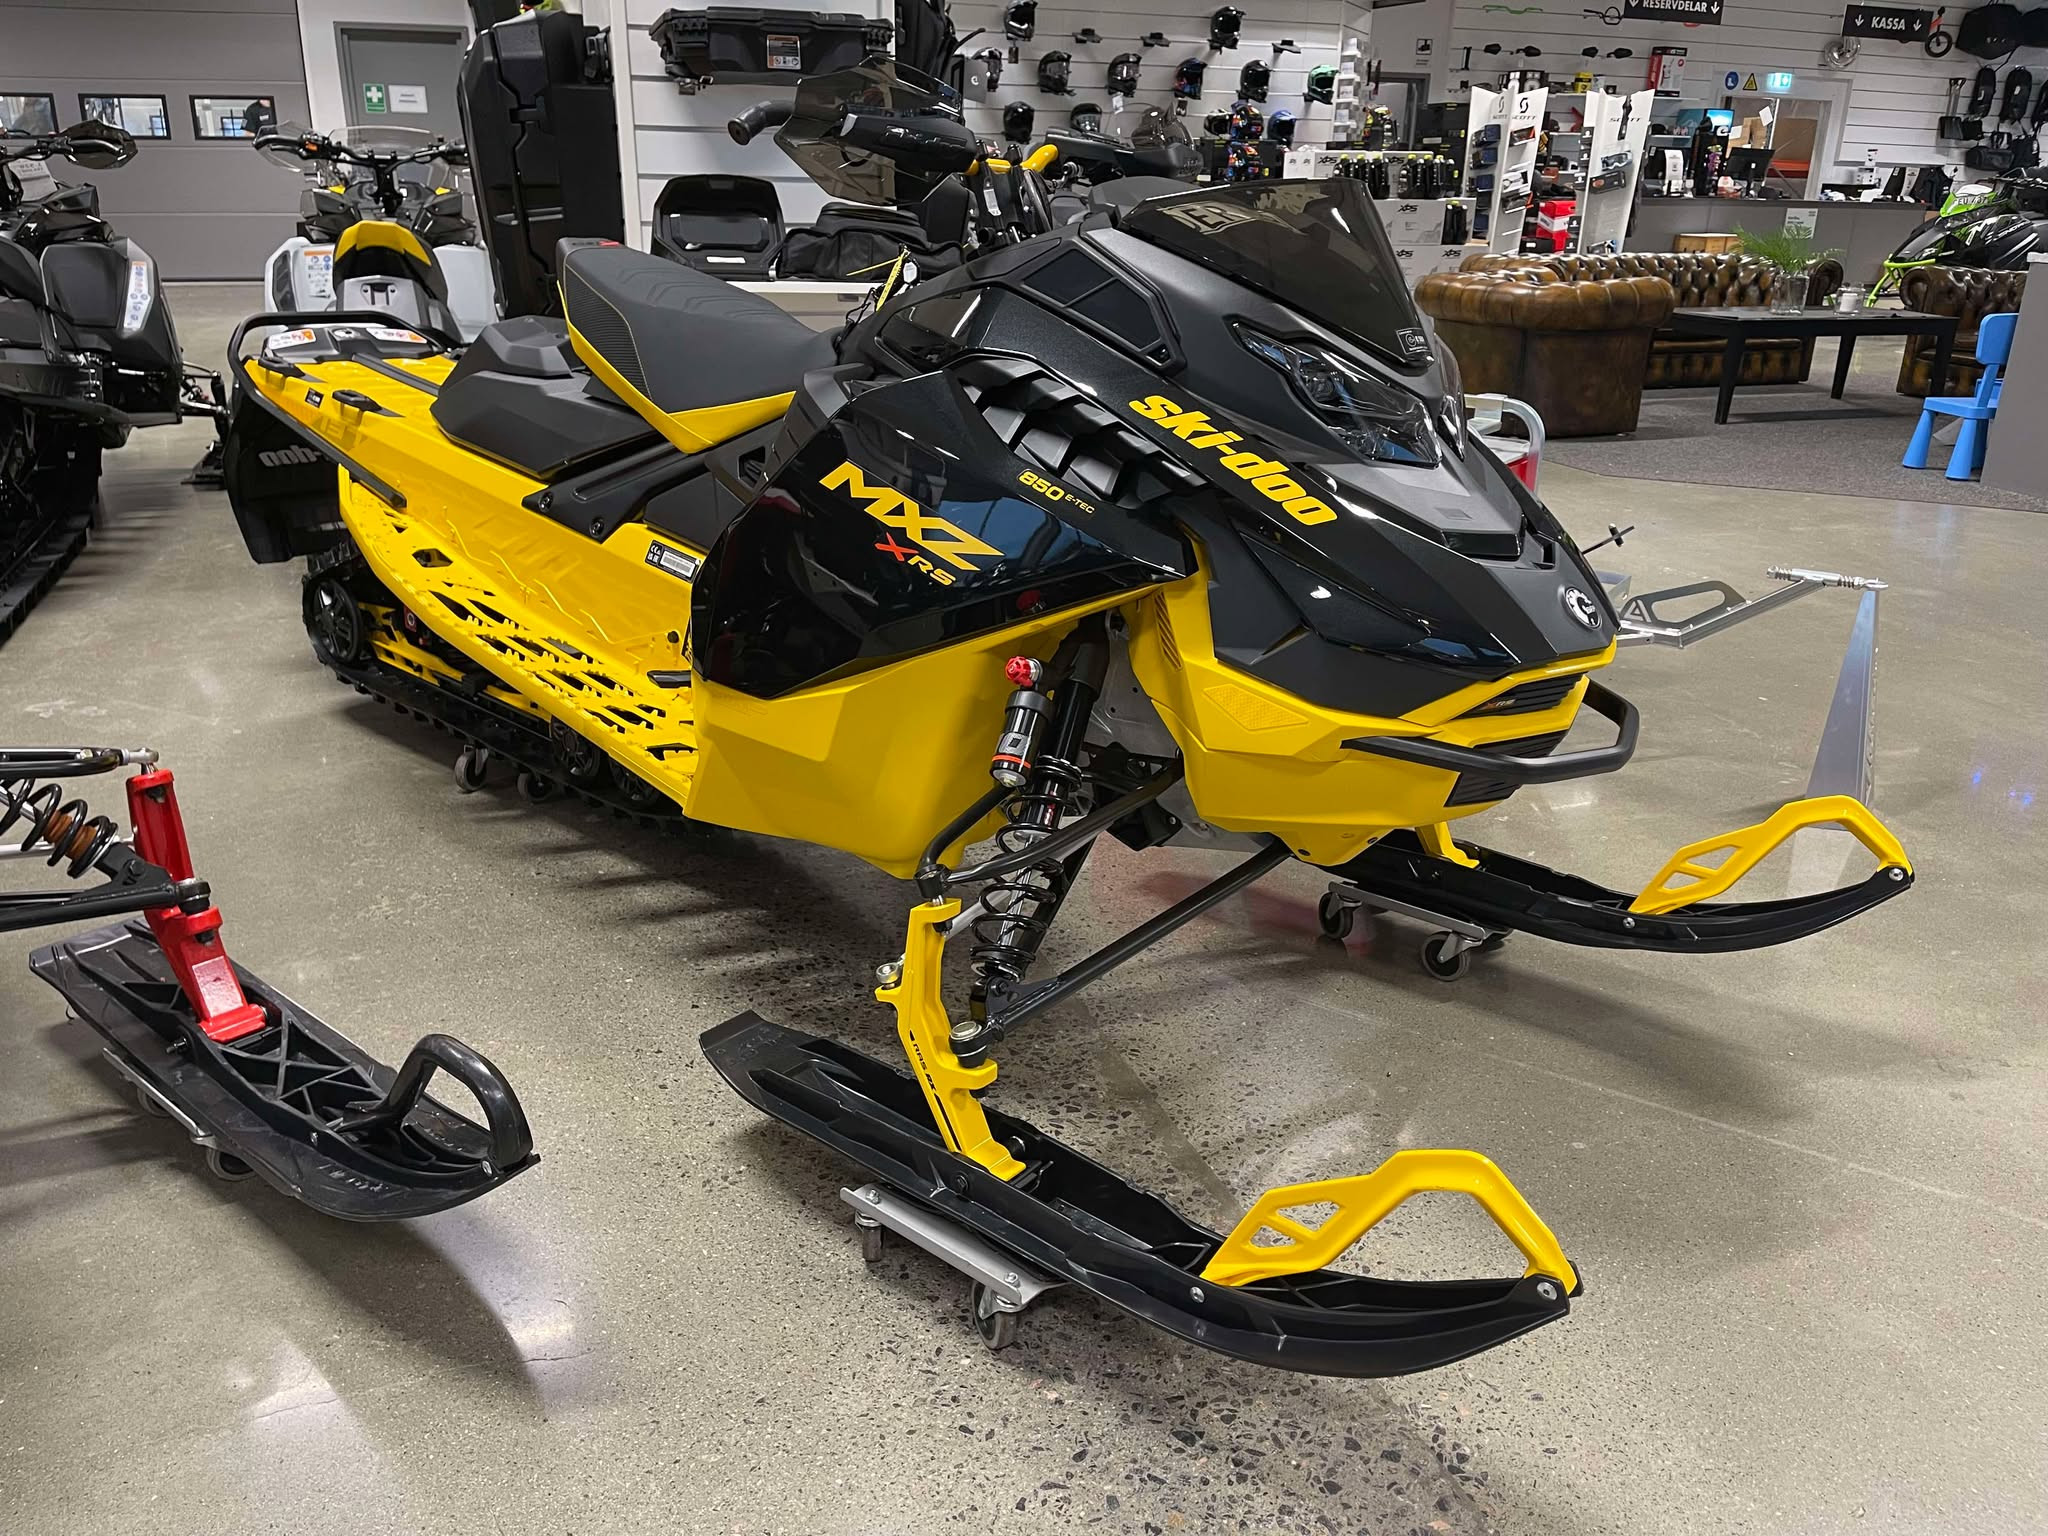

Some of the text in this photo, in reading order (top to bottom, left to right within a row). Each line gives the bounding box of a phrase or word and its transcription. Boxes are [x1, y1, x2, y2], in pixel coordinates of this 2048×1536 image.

[1643, 0, 1707, 13] RESERVDELAR
[1871, 16, 1905, 30] KASSA
[1397, 203, 1419, 213] XPS
[1441, 249, 1462, 258] XPS
[1128, 395, 1338, 526] ski-doo
[1017, 470, 1096, 515] 850 E-TEC
[818, 460, 1005, 571] MXZ
